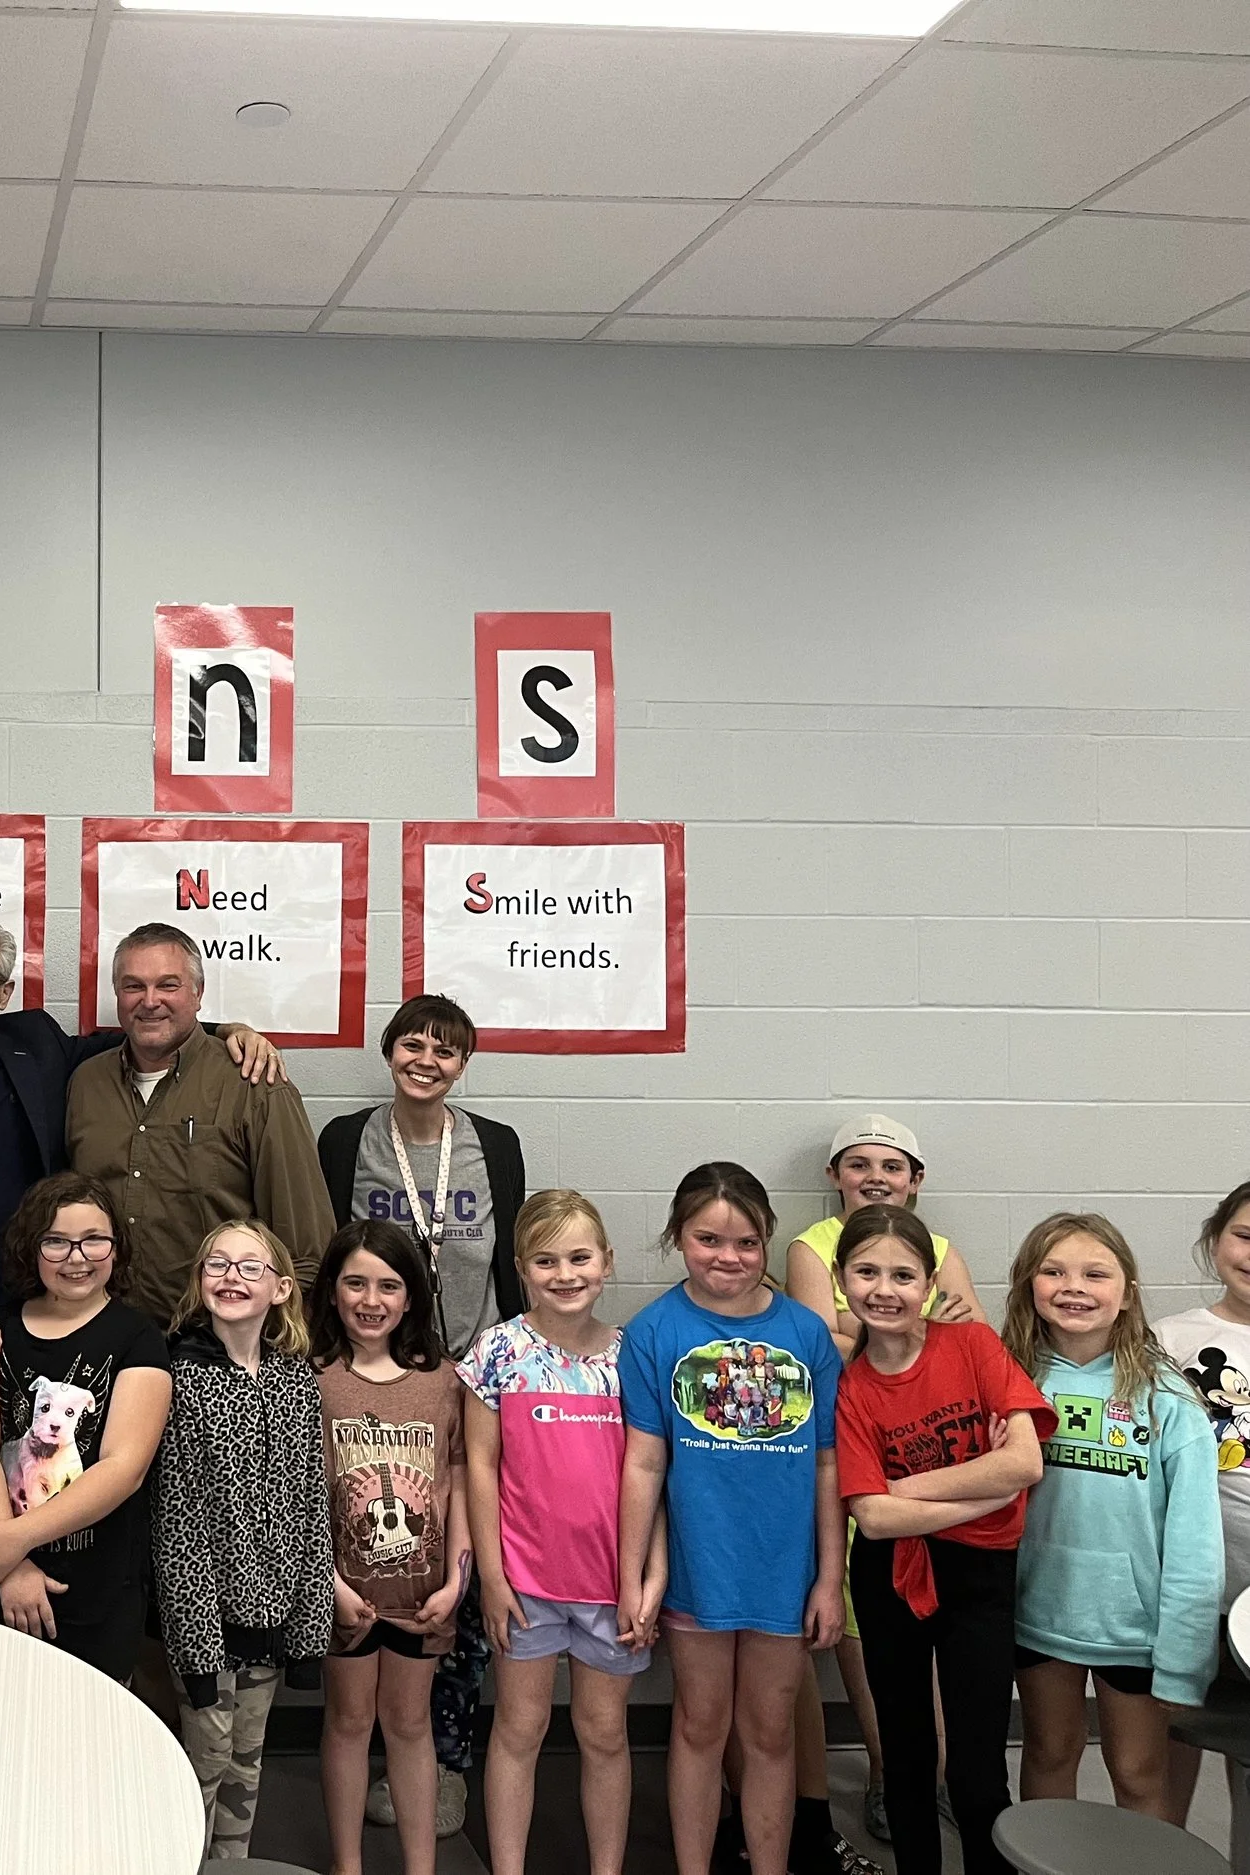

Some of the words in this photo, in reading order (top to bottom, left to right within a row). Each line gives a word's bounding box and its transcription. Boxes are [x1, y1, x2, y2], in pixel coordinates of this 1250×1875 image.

[175, 868, 268, 912] Need
[463, 872, 557, 916] Smile
[567, 887, 632, 915] with
[203, 934, 282, 962] walk.
[507, 940, 620, 969] friends.
[531, 1404, 623, 1430] Champio
[884, 1421, 917, 1442] YOU
[919, 1402, 964, 1427] WANT
[711, 1441, 730, 1451] just
[732, 1443, 761, 1451] wanna
[762, 1443, 786, 1453] have
[1041, 1443, 1149, 1480] NECRAFT
[368, 1547, 393, 1563] MUSIC
[395, 1541, 413, 1555] CITY
